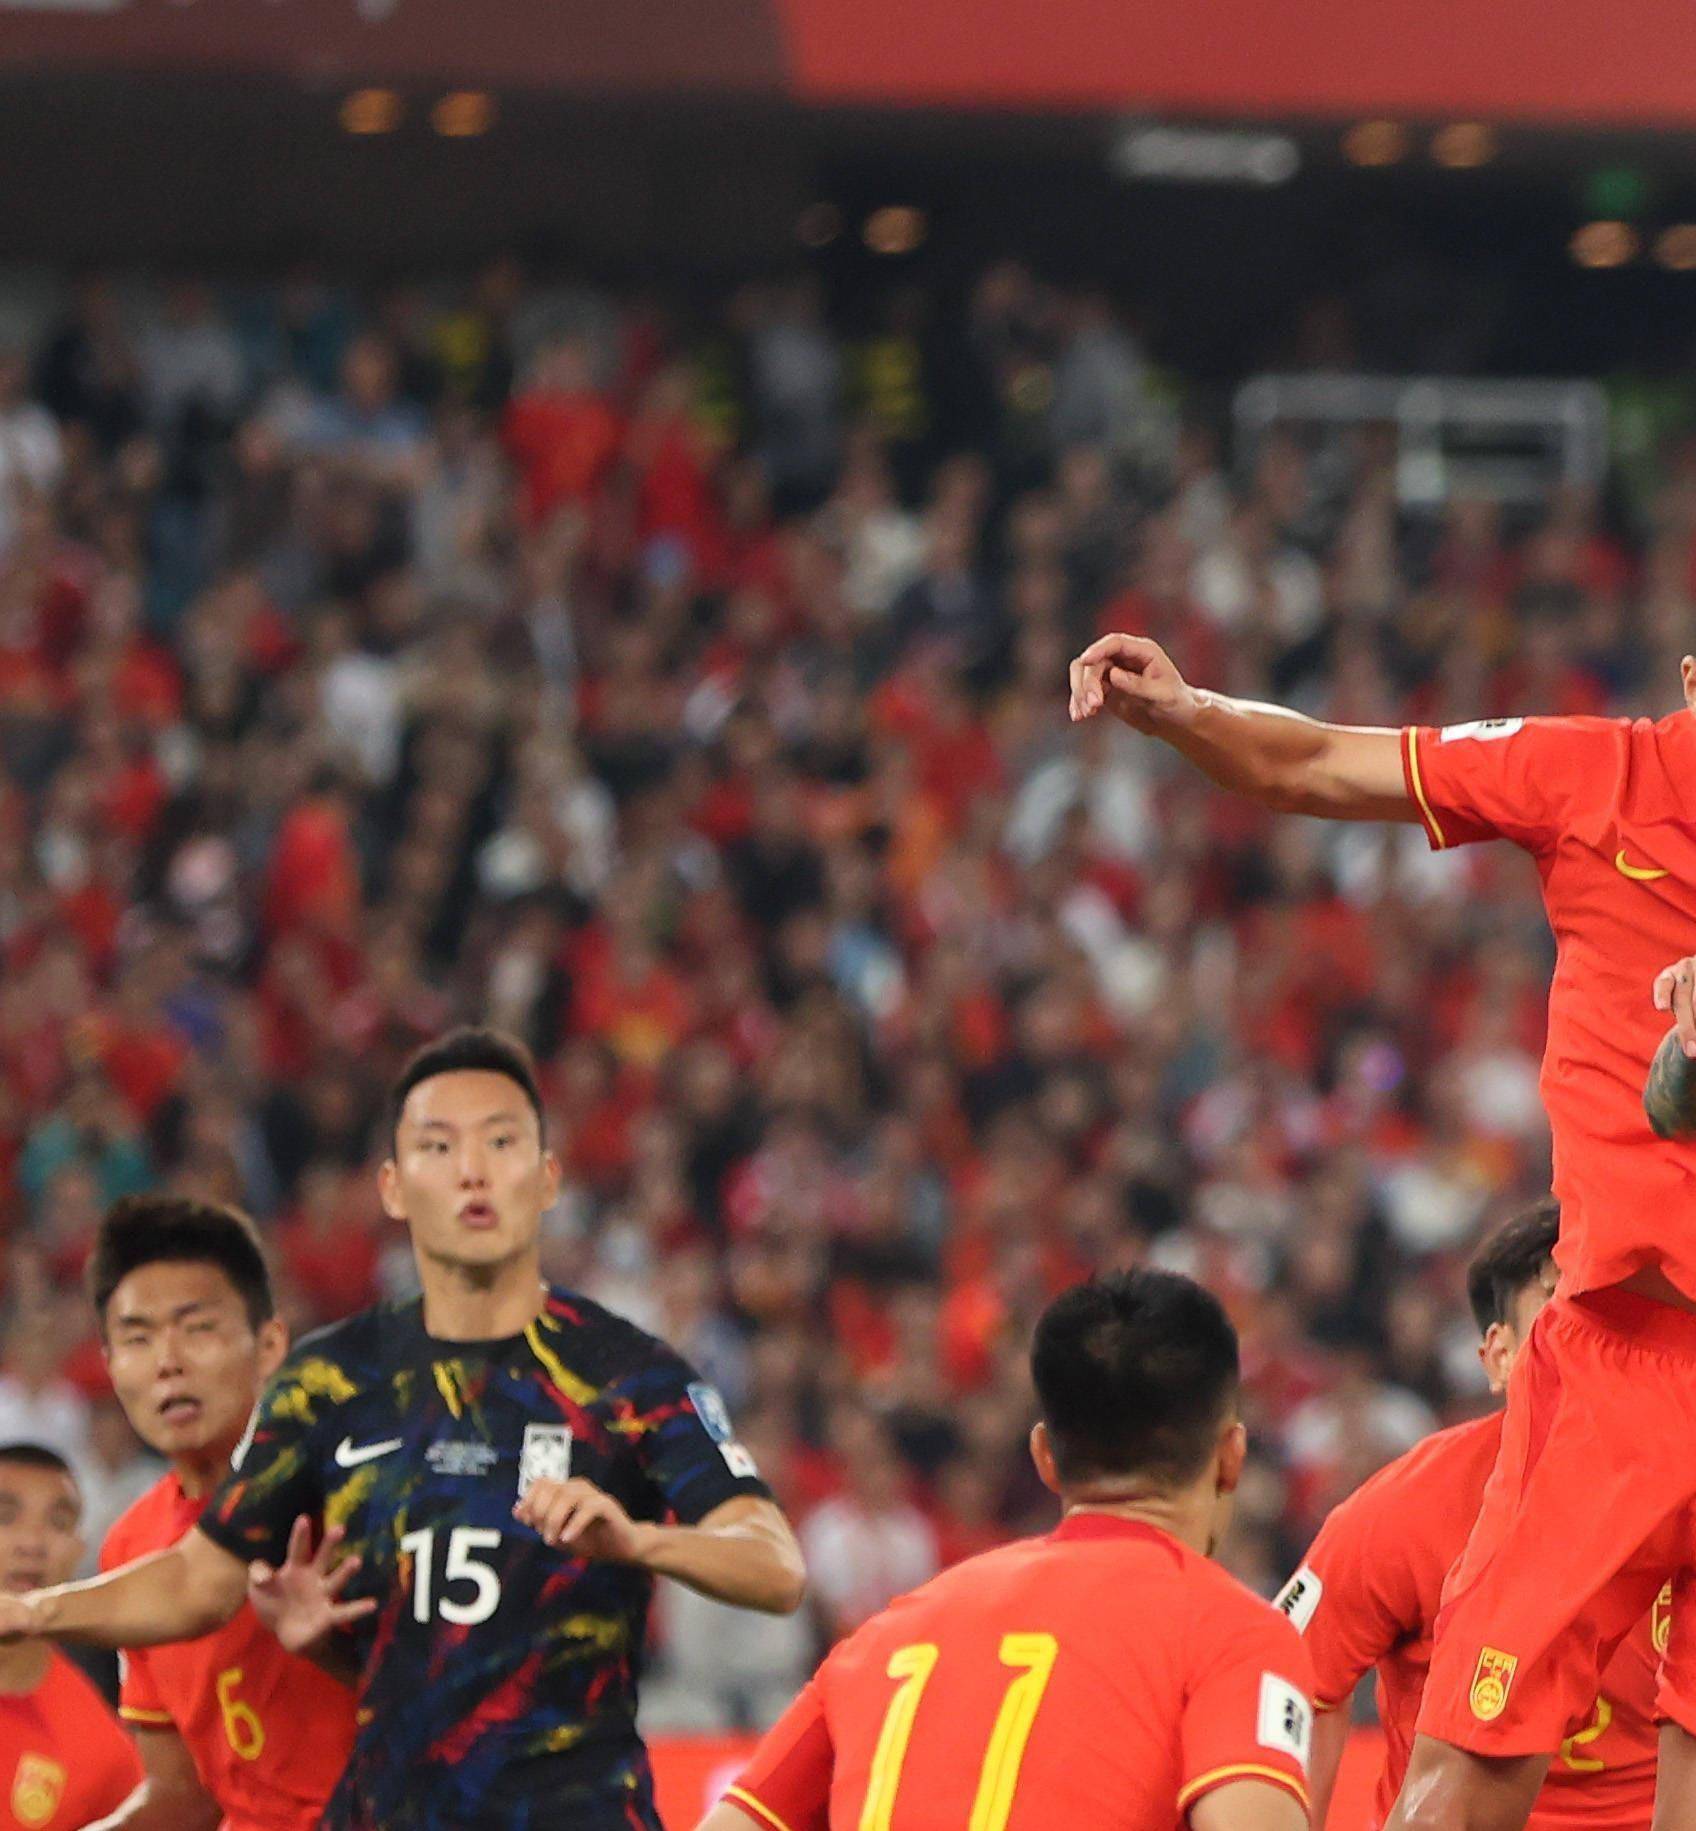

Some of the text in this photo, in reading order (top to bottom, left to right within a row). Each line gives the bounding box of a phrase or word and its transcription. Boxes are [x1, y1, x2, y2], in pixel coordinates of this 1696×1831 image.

[401, 1528, 501, 1625] 15
[217, 1669, 265, 1761] 6
[858, 1632, 1060, 1831] 11
[1560, 1696, 1612, 1771] 2
